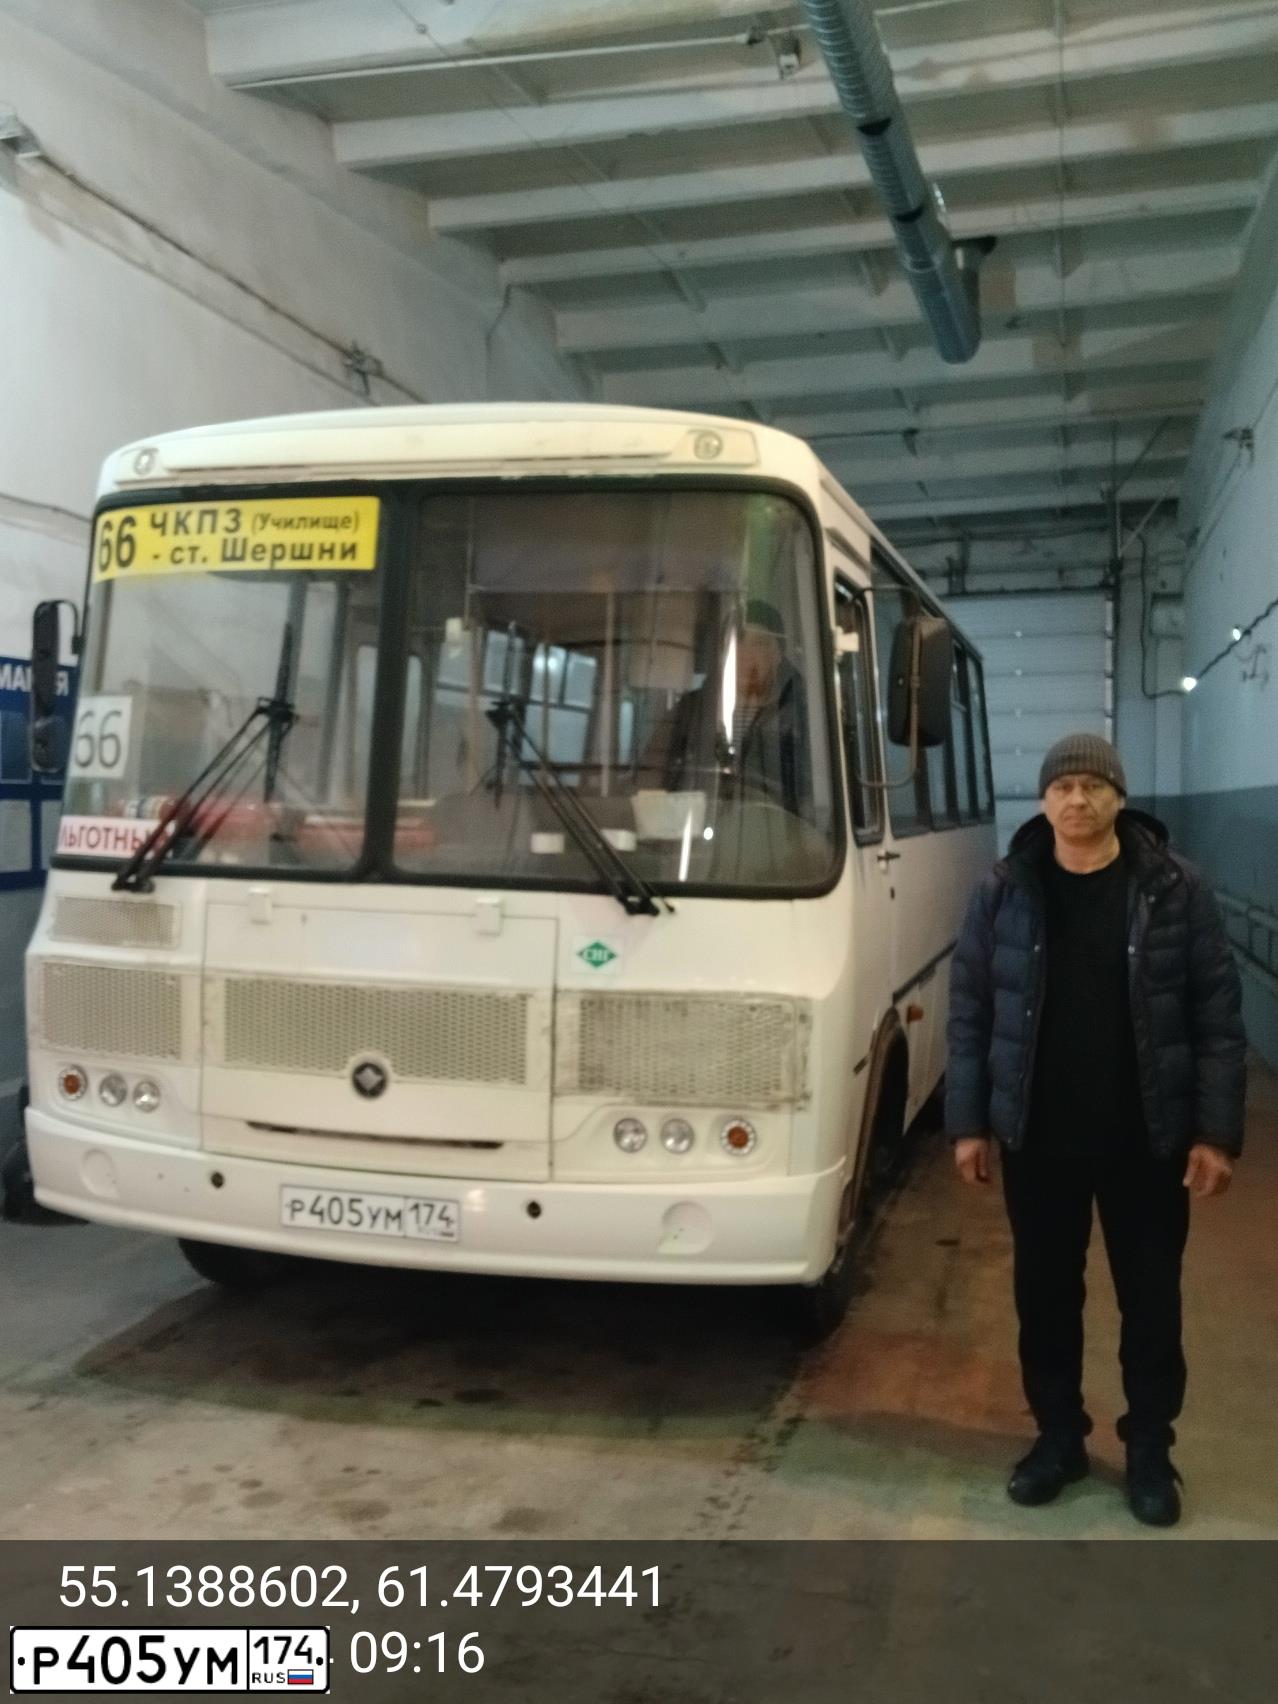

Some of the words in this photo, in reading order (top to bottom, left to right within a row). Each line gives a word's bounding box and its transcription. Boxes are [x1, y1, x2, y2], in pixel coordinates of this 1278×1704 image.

[150, 507, 241, 536] ЧКПЗ
[252, 510, 359, 534] (Училище)
[100, 515, 136, 571] 66
[170, 545, 207, 564] ст.
[221, 536, 357, 567] Шершни
[75, 710, 122, 769] 66
[409, 1202, 452, 1228] 174
